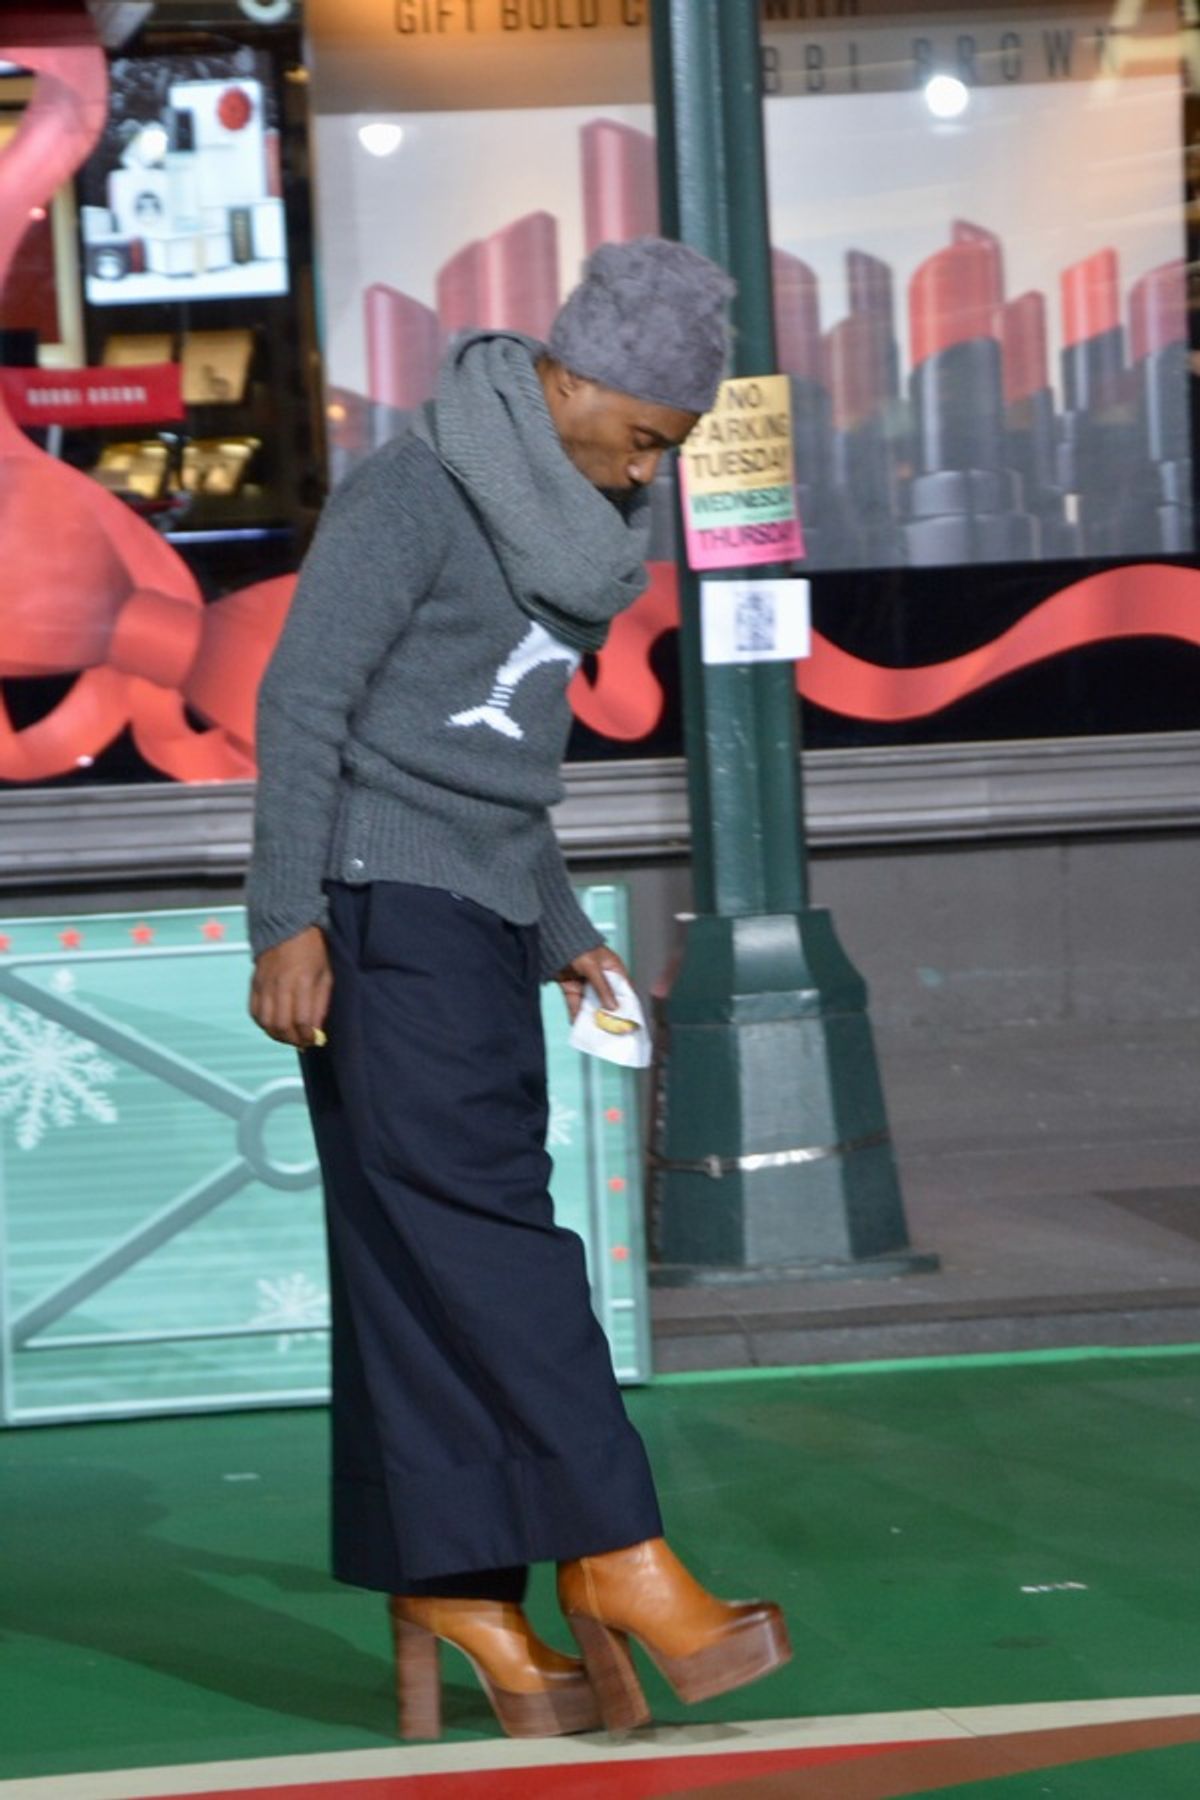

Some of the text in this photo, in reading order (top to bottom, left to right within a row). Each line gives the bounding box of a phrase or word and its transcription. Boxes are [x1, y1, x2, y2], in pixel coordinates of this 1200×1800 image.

[394, 0, 476, 34] GIFT
[502, 0, 599, 31] BOLD
[761, 41, 859, 94] BBI
[727, 383, 763, 409] NO
